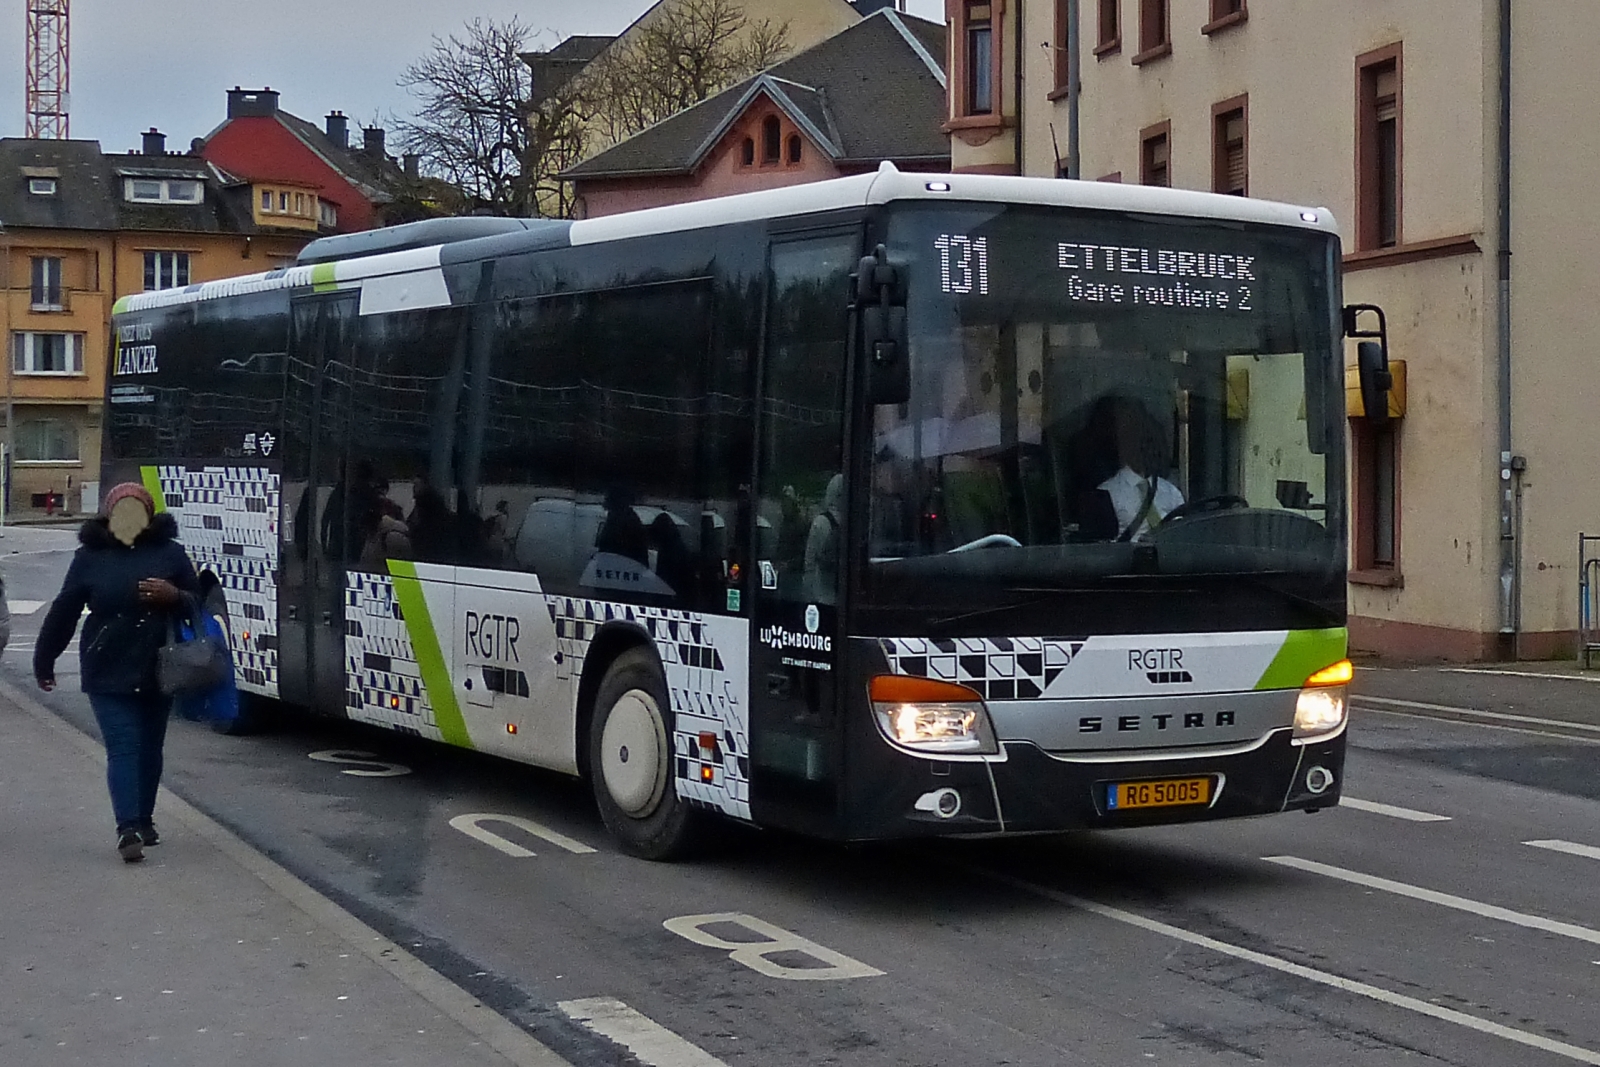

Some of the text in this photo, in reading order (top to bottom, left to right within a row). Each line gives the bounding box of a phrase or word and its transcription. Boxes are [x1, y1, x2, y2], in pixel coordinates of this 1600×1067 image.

[934, 234, 988, 294] 131
[1058, 242, 1255, 281] ETTELBRUCK
[1068, 275, 1124, 303] Gare
[1238, 286, 1252, 310] 2
[464, 611, 520, 663] RGTR
[760, 624, 831, 652] LUXEMBOURG
[1128, 648, 1183, 670] RGTR
[1079, 711, 1235, 732] SETRA
[1126, 785, 1149, 804] RG
[1154, 781, 1200, 803] 5005
